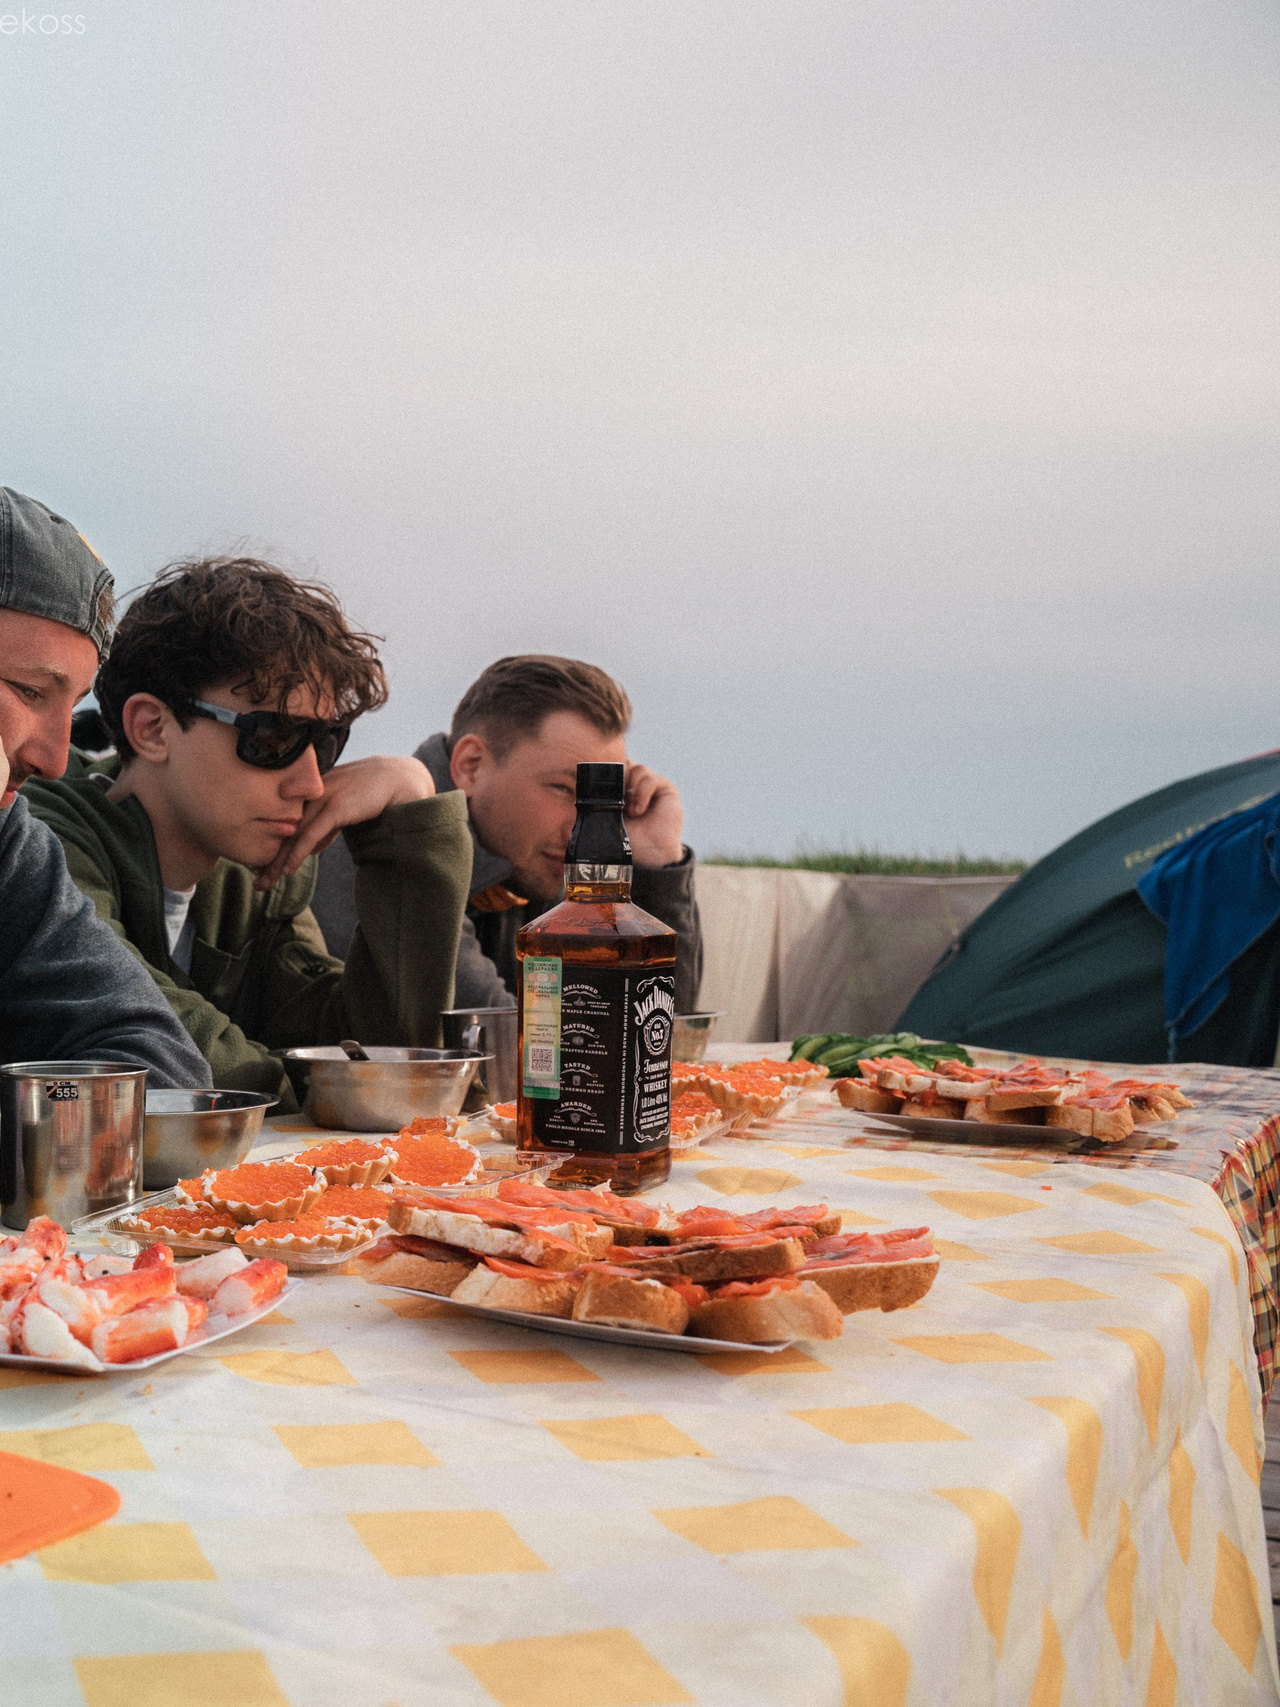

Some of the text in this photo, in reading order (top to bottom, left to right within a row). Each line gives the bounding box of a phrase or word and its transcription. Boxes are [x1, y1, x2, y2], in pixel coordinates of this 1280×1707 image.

[563, 984, 599, 994] MELLOWED
[563, 1023, 595, 1032] MATURED
[564, 1062, 591, 1071] TASTED
[643, 1078, 668, 1093] WHISKEY
[56, 1087, 78, 1098] 555
[560, 1101, 592, 1111] AWARDED
